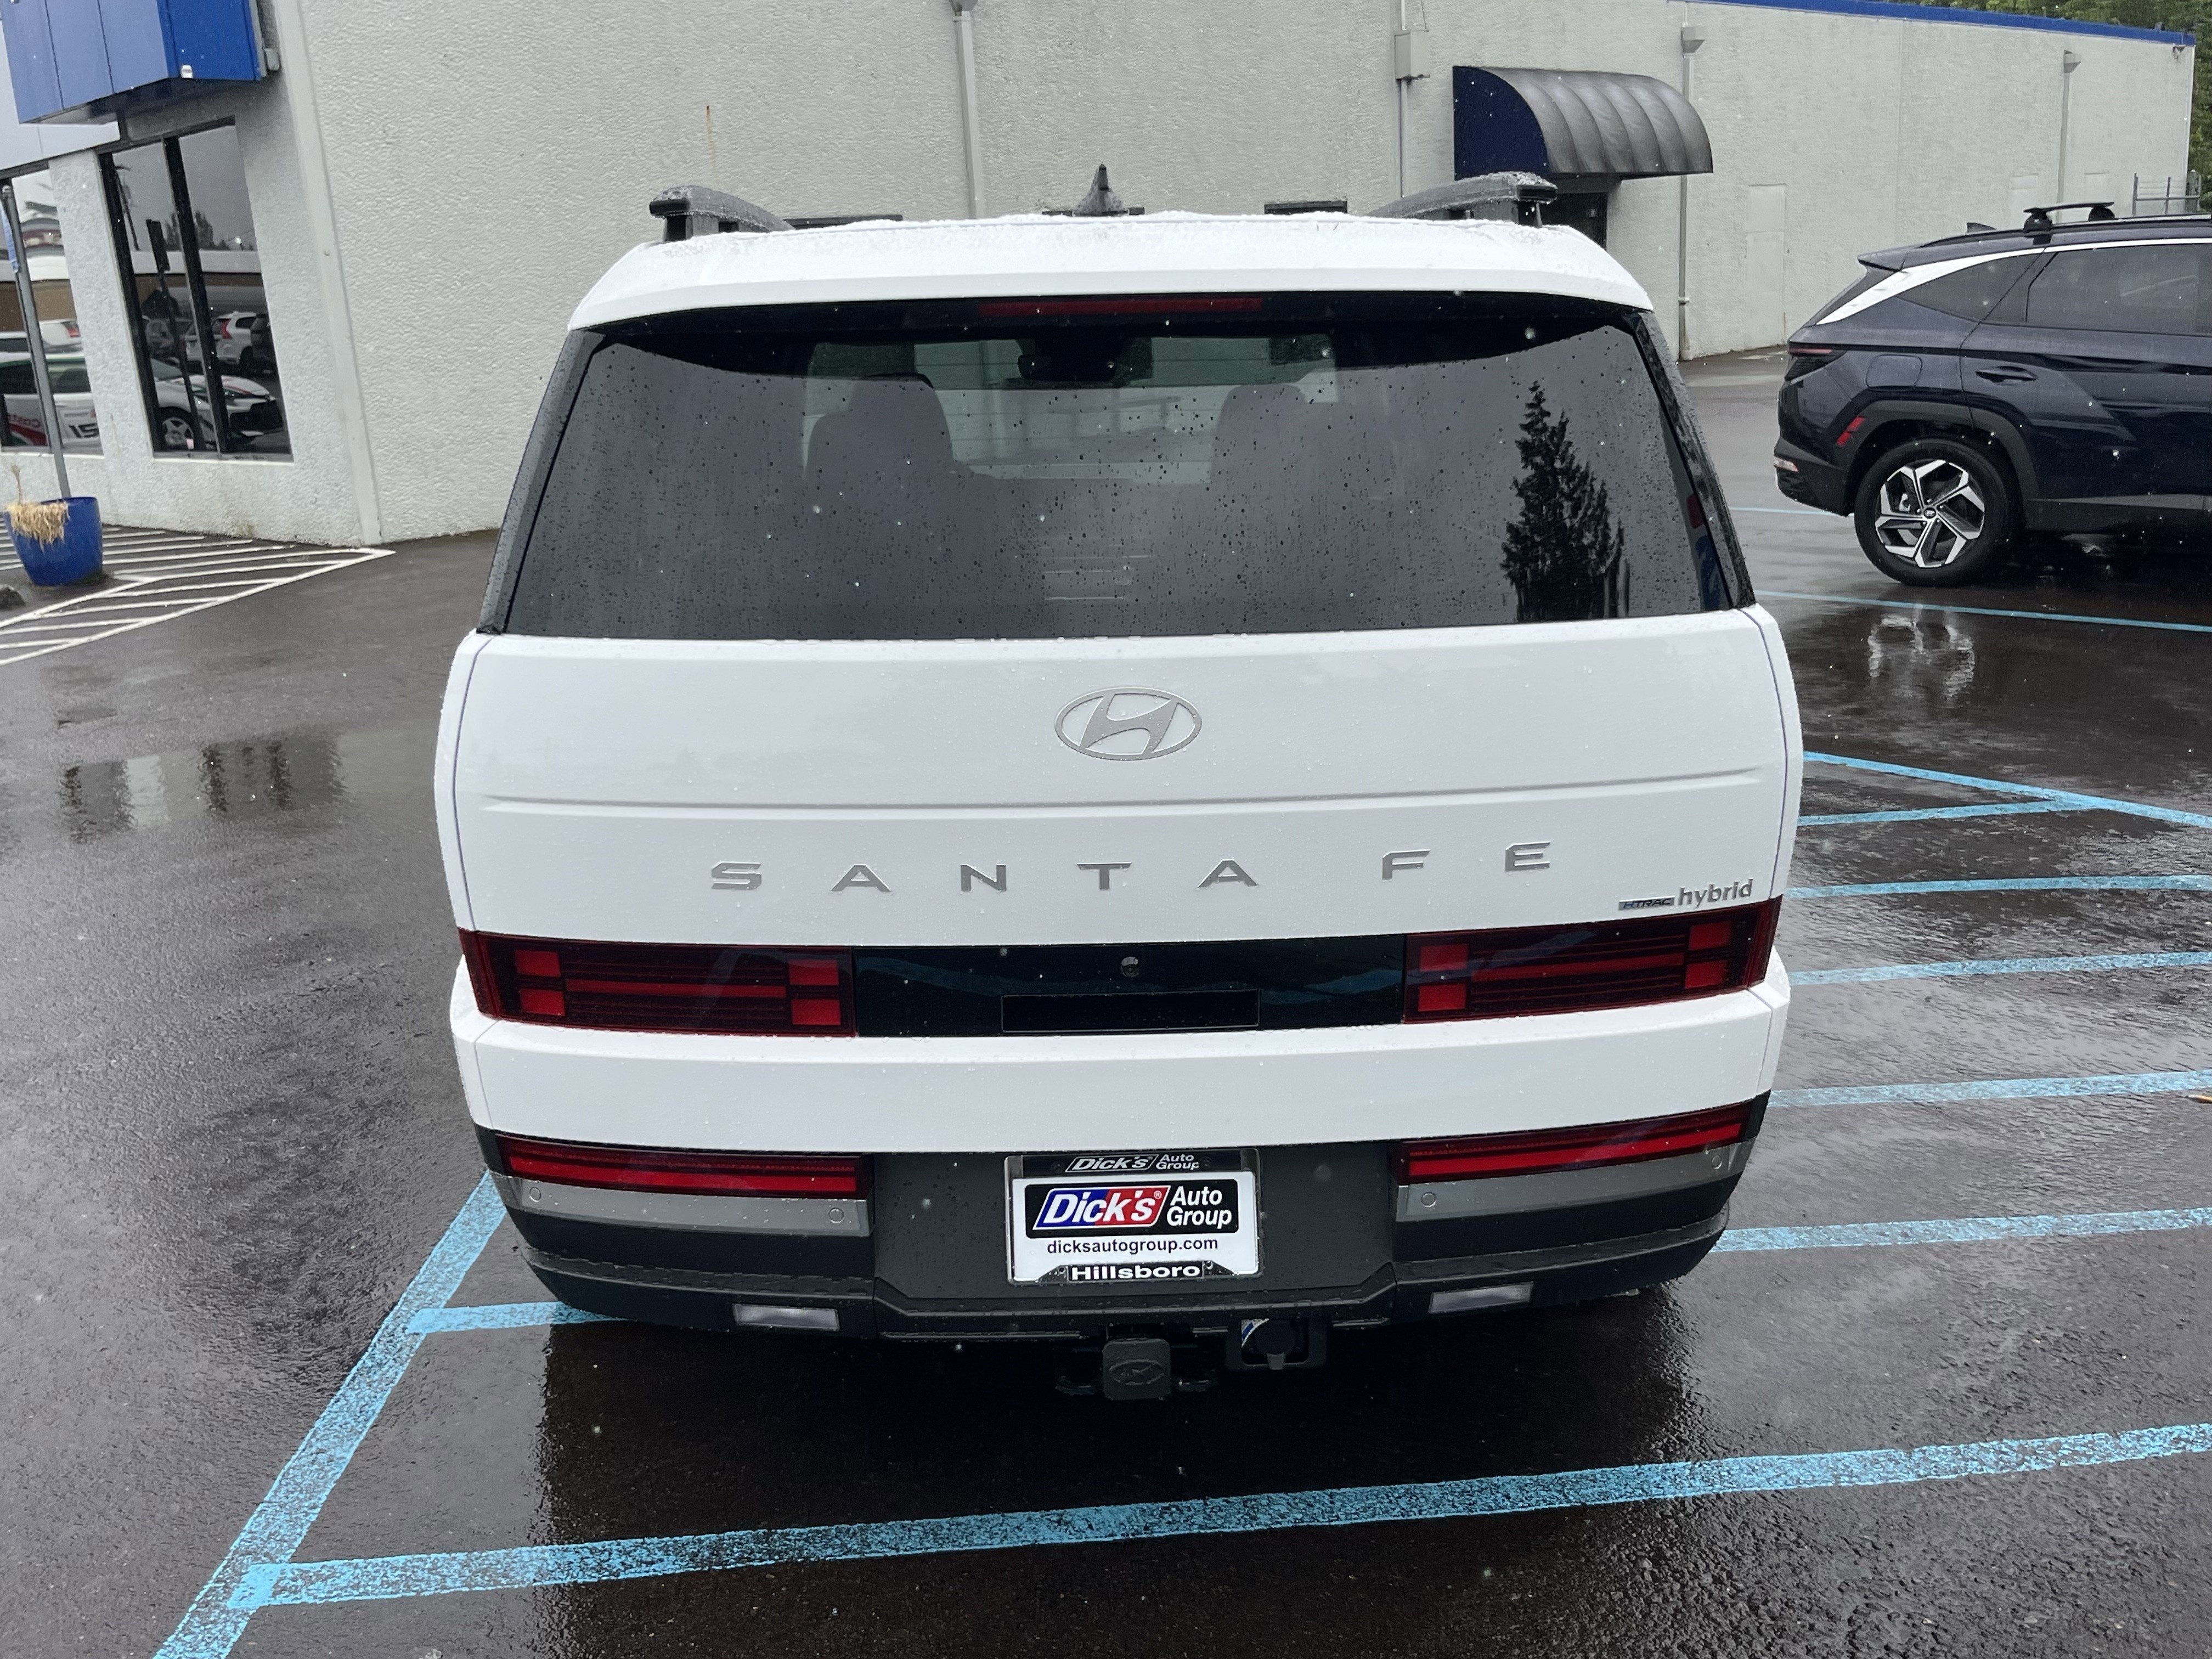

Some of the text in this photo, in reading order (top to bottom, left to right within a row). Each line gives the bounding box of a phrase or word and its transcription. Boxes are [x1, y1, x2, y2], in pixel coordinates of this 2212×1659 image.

[712, 840, 1551, 893] SANTA FE
[1623, 877, 1753, 909] HTRAC hybrid
[1071, 1156, 1149, 1170] Dick's
[1155, 1161, 1199, 1170] Group
[1159, 1153, 1195, 1163] Auto
[1170, 1186, 1223, 1206] Auto
[1043, 1190, 1155, 1223] Dick's
[1166, 1206, 1232, 1229] Group
[1047, 1239, 1218, 1255] dicksautogroup.com
[1071, 1265, 1200, 1280] Hillsboro
